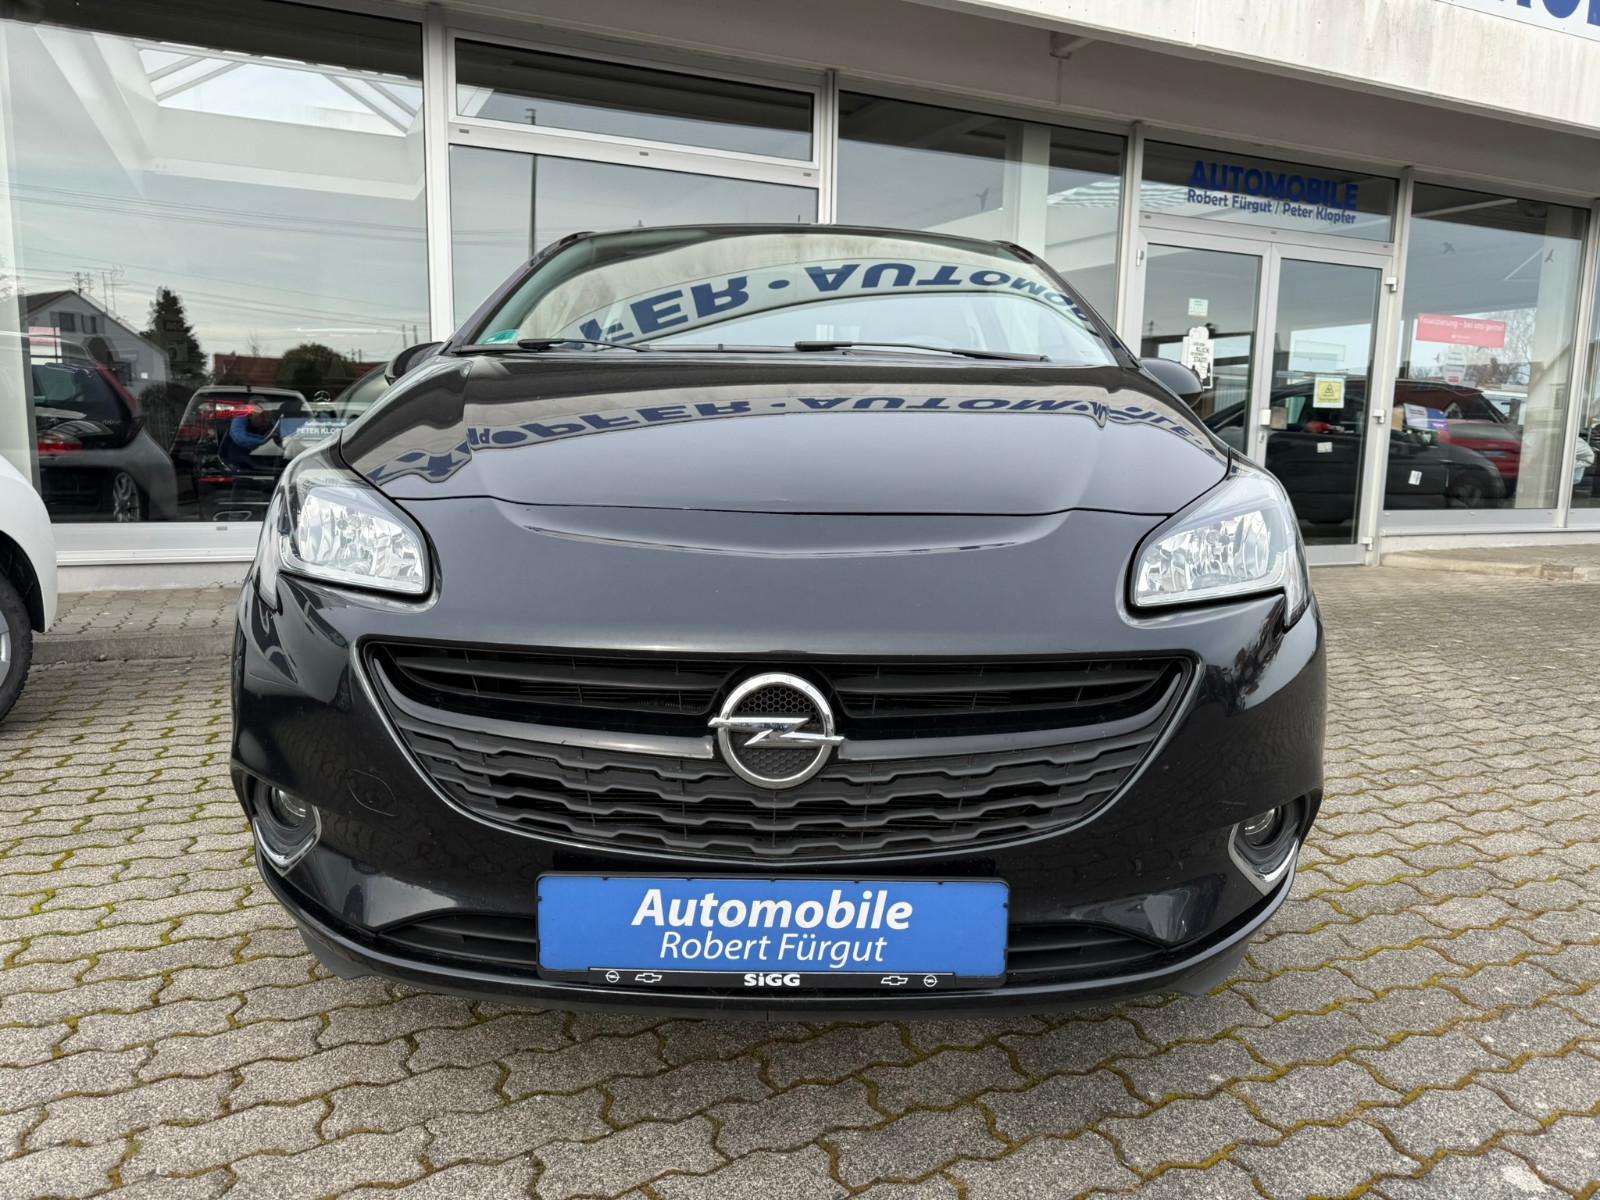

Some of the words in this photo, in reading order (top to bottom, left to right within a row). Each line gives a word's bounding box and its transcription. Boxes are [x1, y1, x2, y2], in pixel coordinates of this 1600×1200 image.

[1187, 160, 1358, 210] AUTOMOBILE
[1187, 188, 1229, 207] Robert
[1231, 195, 1273, 214] Fürgut
[1282, 202, 1313, 218] Peter
[1315, 208, 1356, 224] Klopfer
[631, 888, 913, 930] Automobile
[660, 930, 770, 961] Robert
[777, 933, 887, 969] Fürgut
